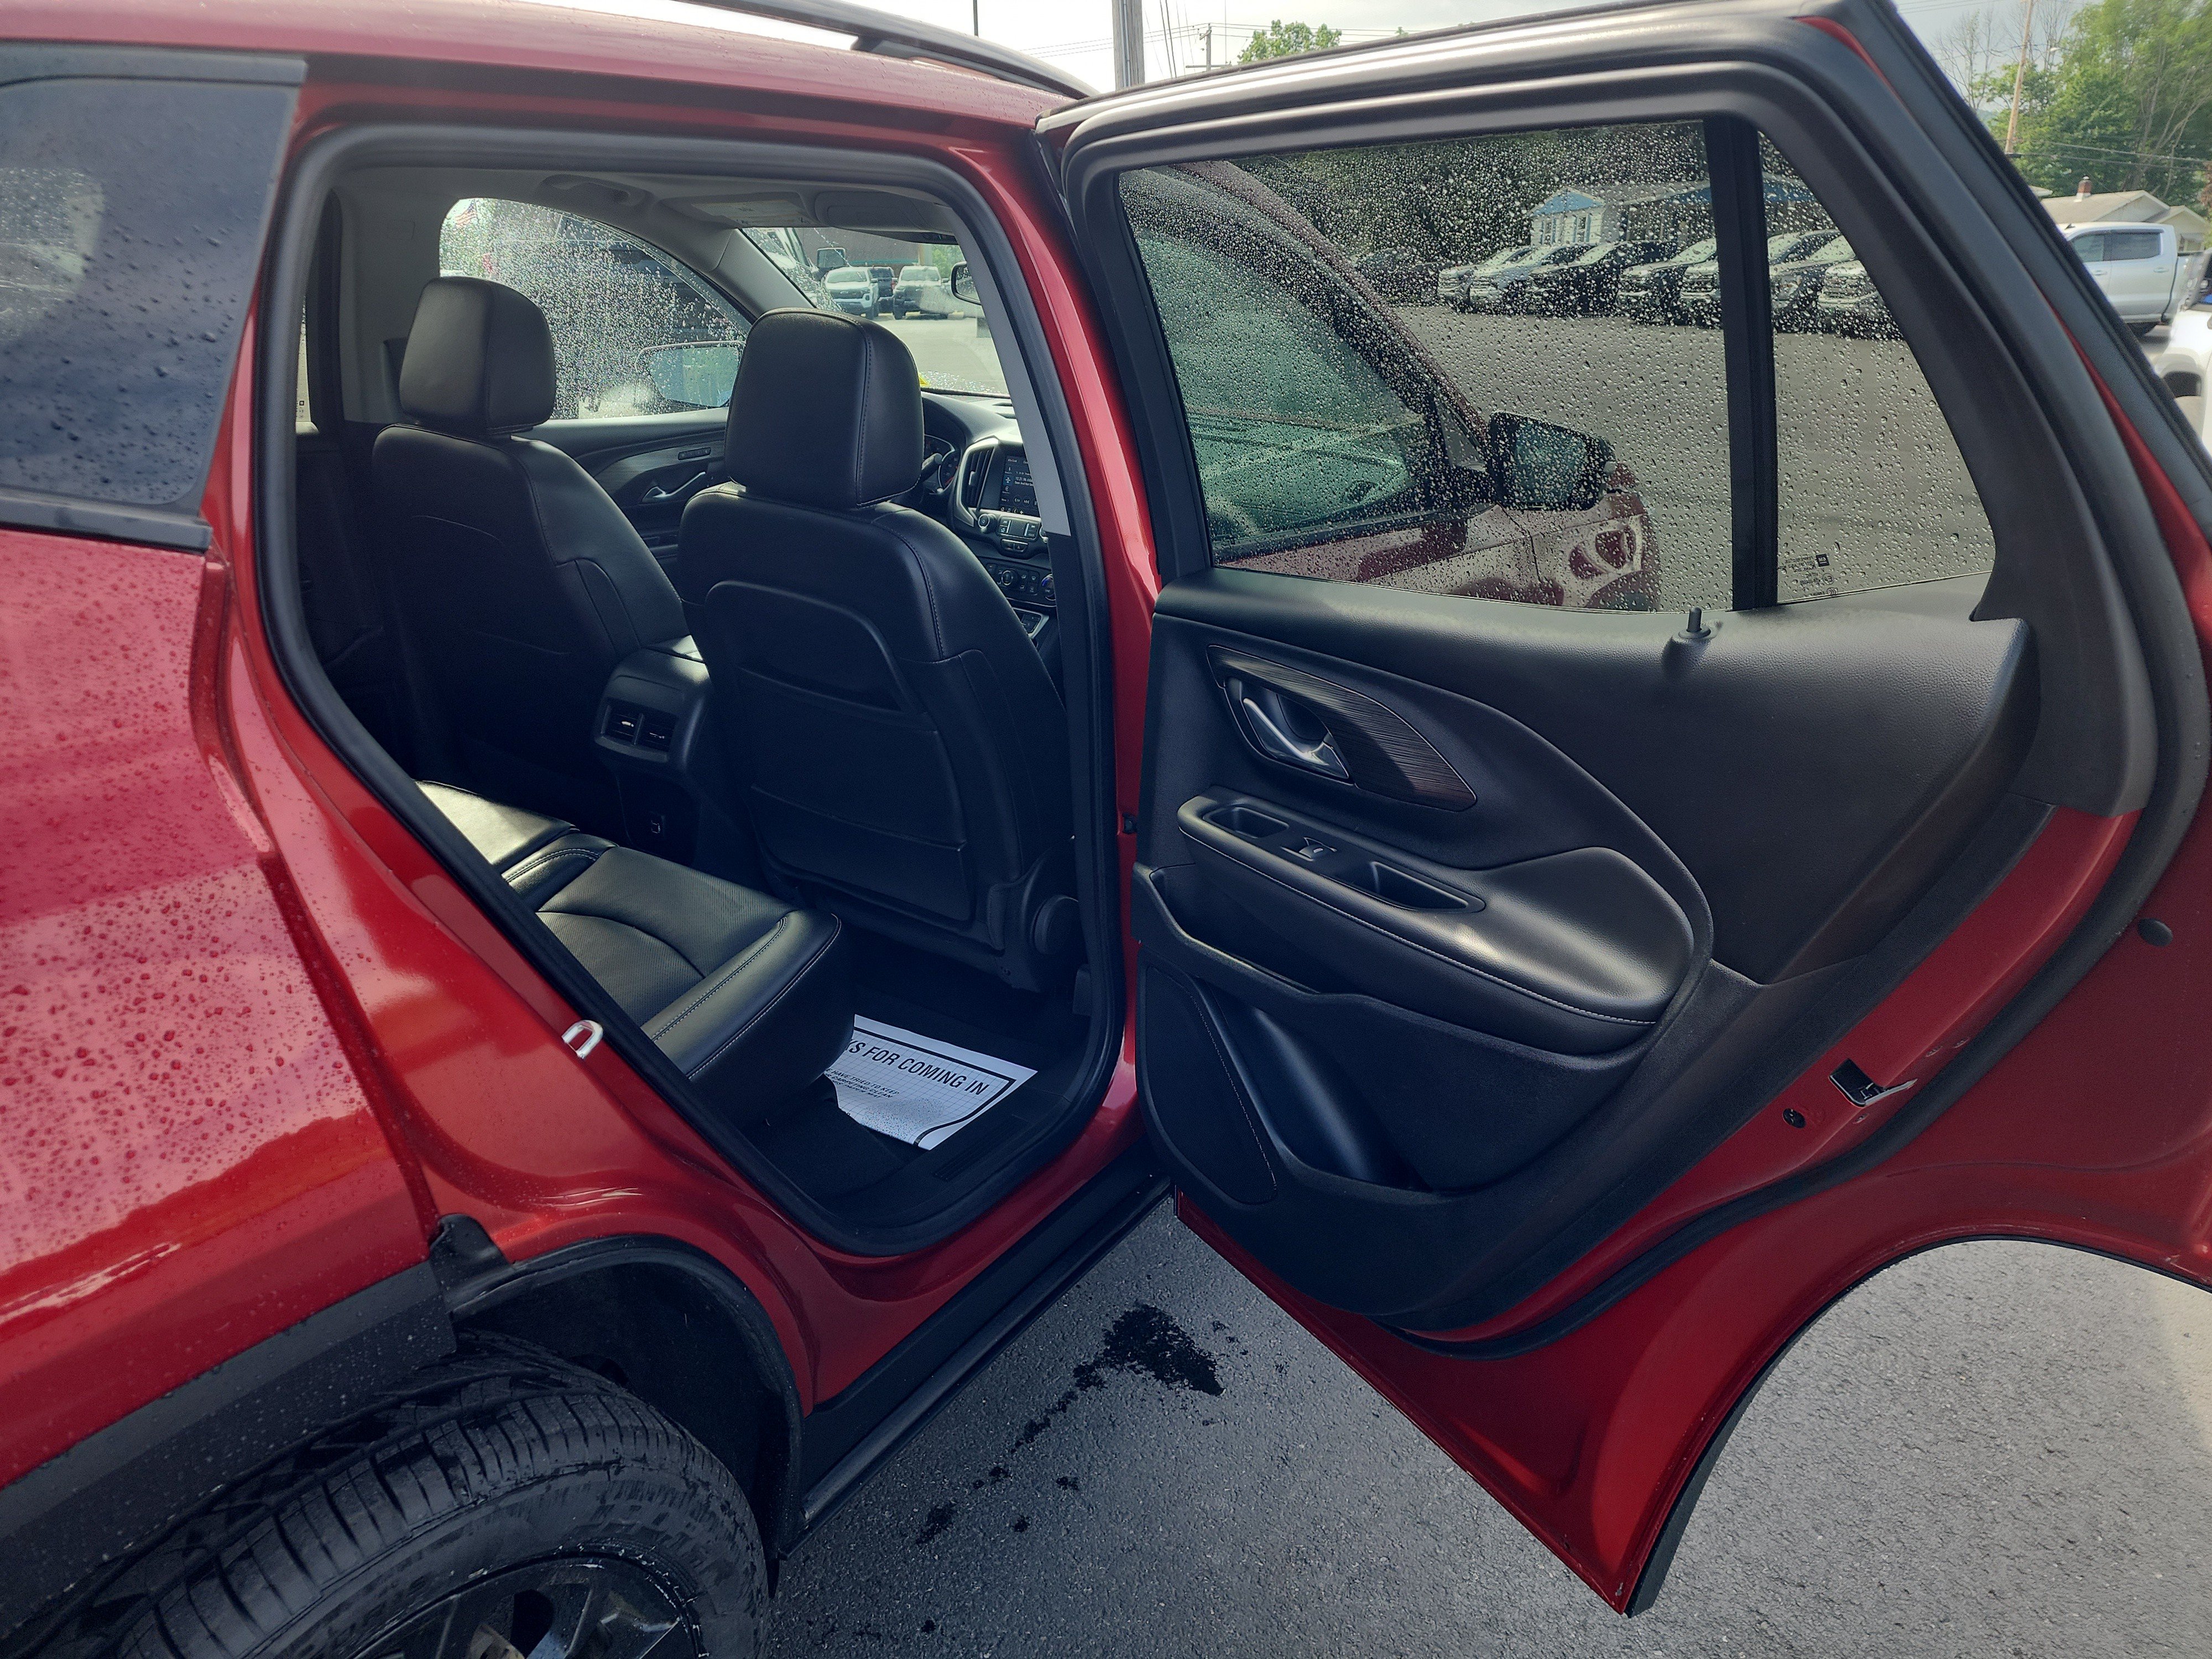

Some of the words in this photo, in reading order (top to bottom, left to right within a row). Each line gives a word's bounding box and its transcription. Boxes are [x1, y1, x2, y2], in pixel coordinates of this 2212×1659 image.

[851, 1076, 871, 1086] TRIED
[862, 1046, 900, 1066] FOR
[898, 1058, 967, 1087] COMING
[965, 1080, 989, 1095] IN
[831, 1076, 870, 1090] CARPETING
[869, 1089, 893, 1098] CLEAN
